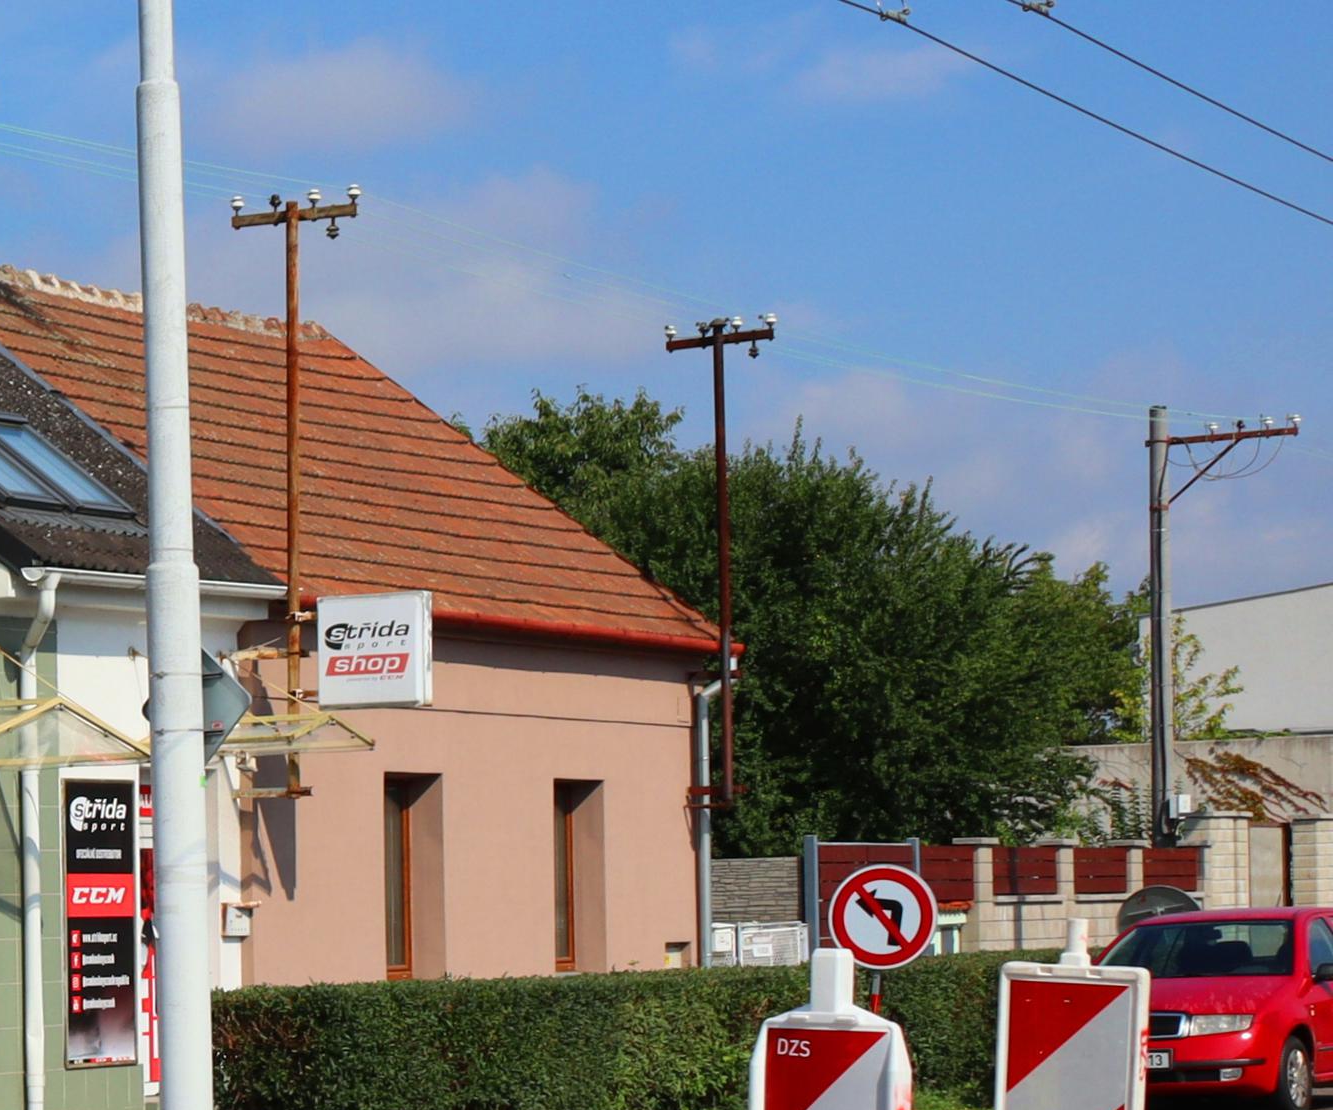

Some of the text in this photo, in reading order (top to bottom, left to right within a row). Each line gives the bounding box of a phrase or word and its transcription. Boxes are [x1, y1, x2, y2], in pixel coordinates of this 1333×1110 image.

[344, 639, 406, 651] sport
[334, 655, 401, 675] shop
[82, 822, 126, 832] sport
[72, 887, 126, 904] CCM
[777, 1038, 811, 1057] DZS
